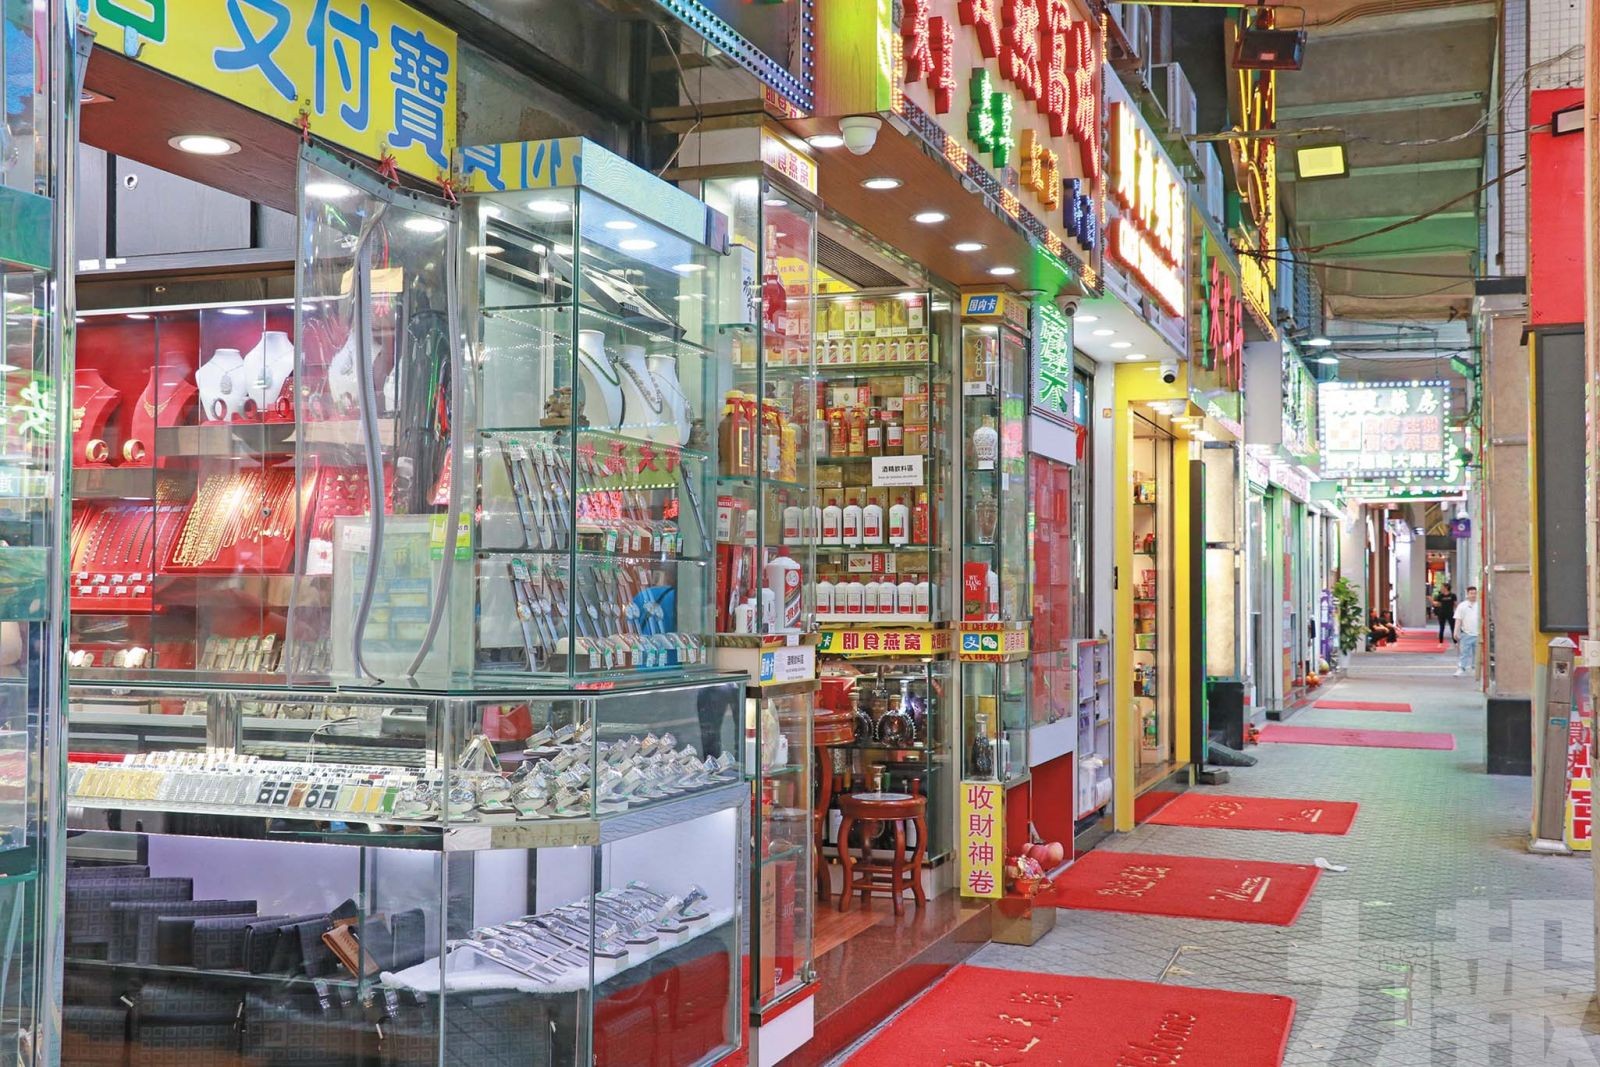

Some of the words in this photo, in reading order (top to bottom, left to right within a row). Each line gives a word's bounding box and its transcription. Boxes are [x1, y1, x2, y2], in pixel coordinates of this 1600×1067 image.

[968, 298, 996, 312] 国内卡
[967, 785, 994, 895] 收財神卷
